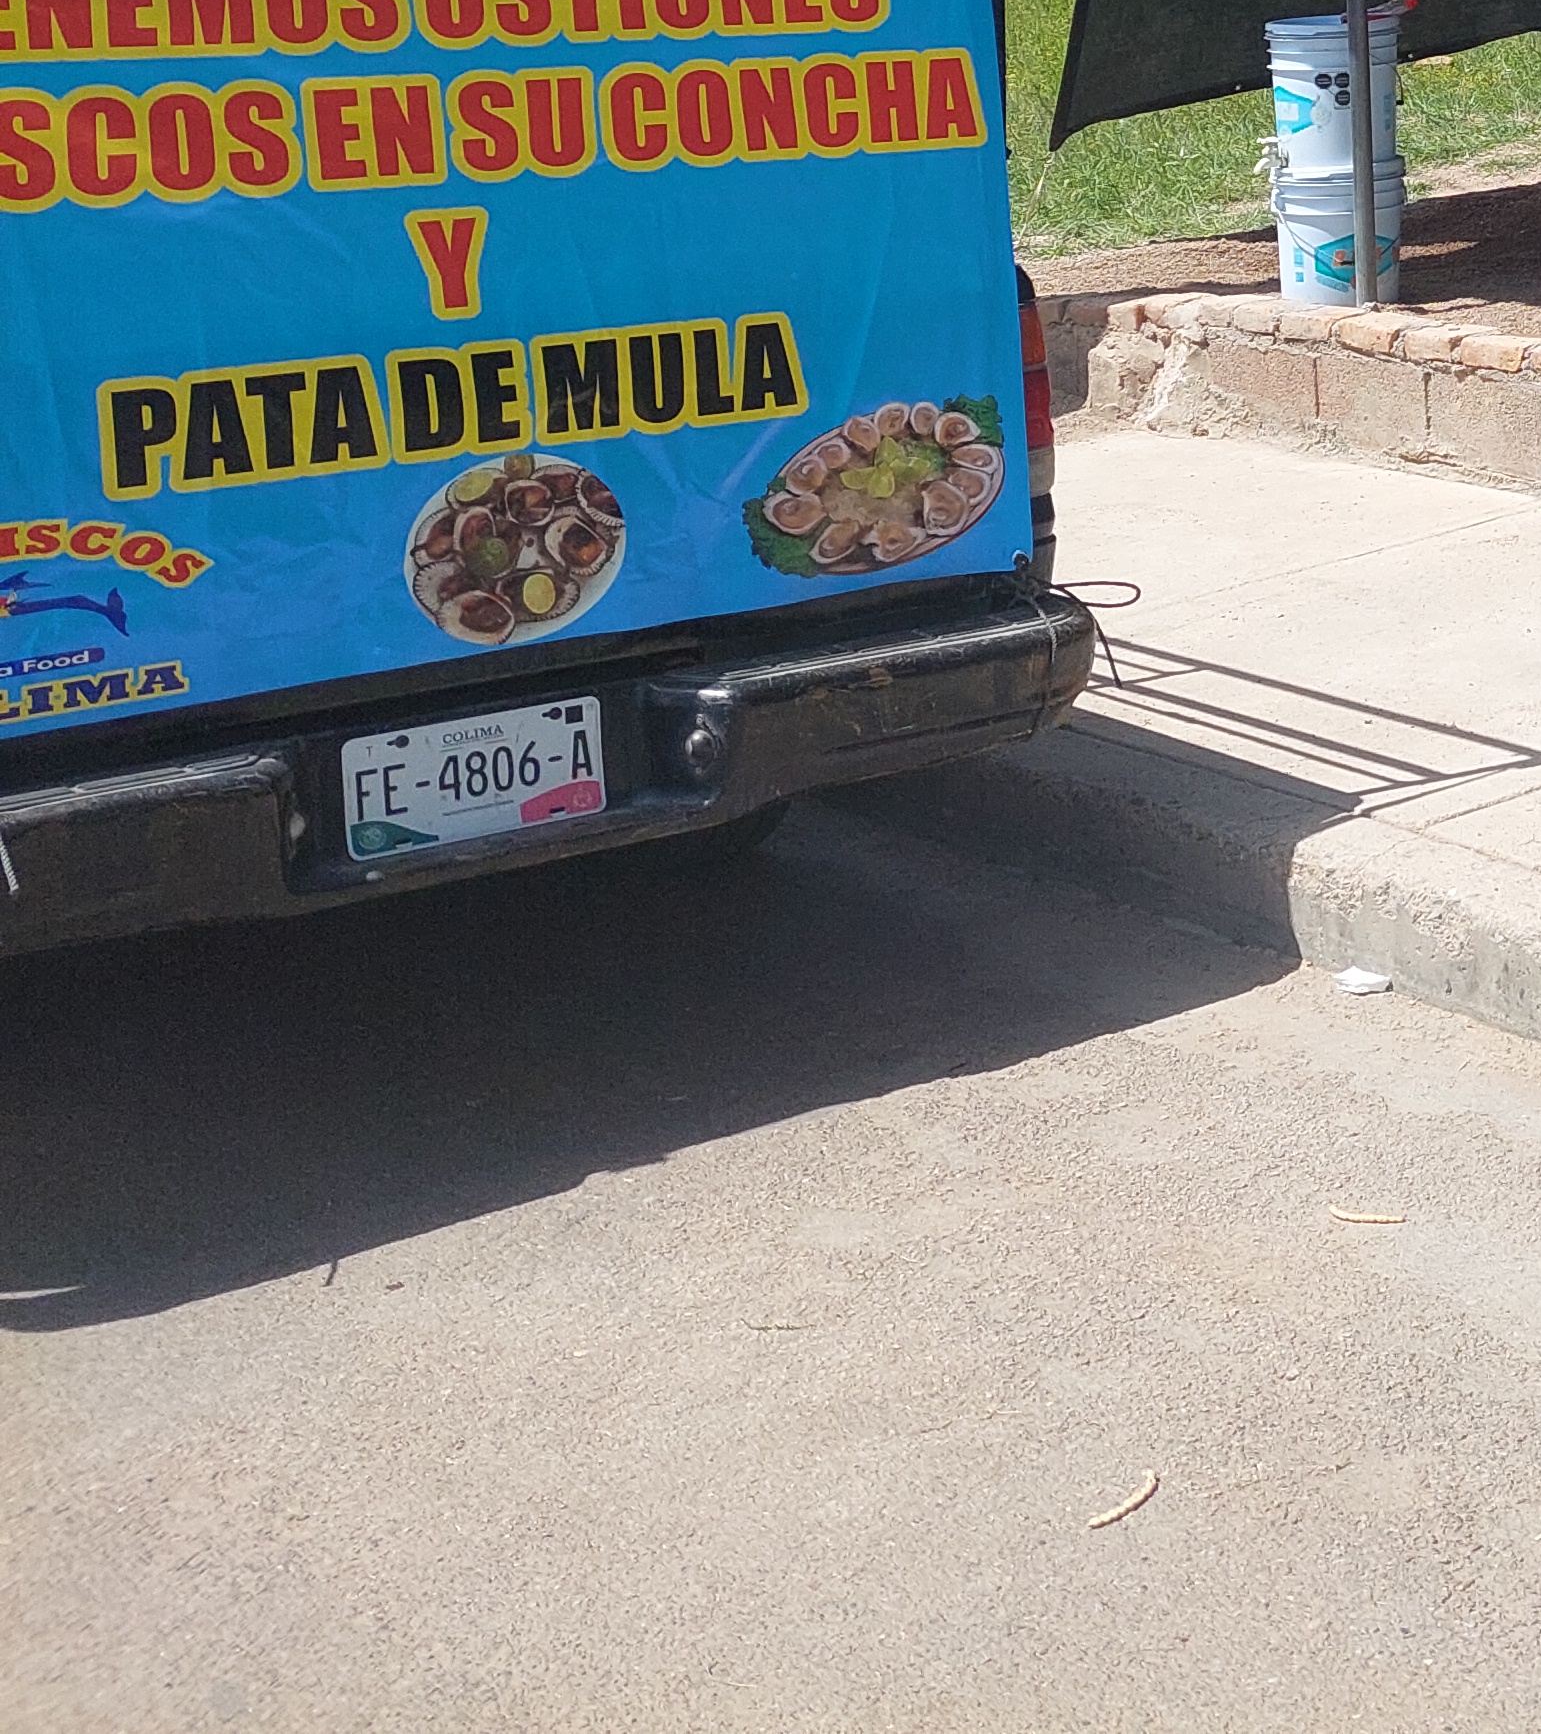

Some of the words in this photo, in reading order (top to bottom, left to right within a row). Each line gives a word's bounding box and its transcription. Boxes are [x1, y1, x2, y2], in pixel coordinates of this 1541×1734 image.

[312, 84, 435, 181] EN
[457, 77, 586, 172] SU
[609, 57, 979, 162] CONCHA
[416, 216, 477, 309] Y
[109, 365, 378, 490] PATA
[397, 350, 521, 453] DE
[540, 322, 798, 434] MULA
[22, 650, 90, 673] Food
[354, 729, 594, 822] FE-4806-A
[442, 724, 504, 745] COLIMA
